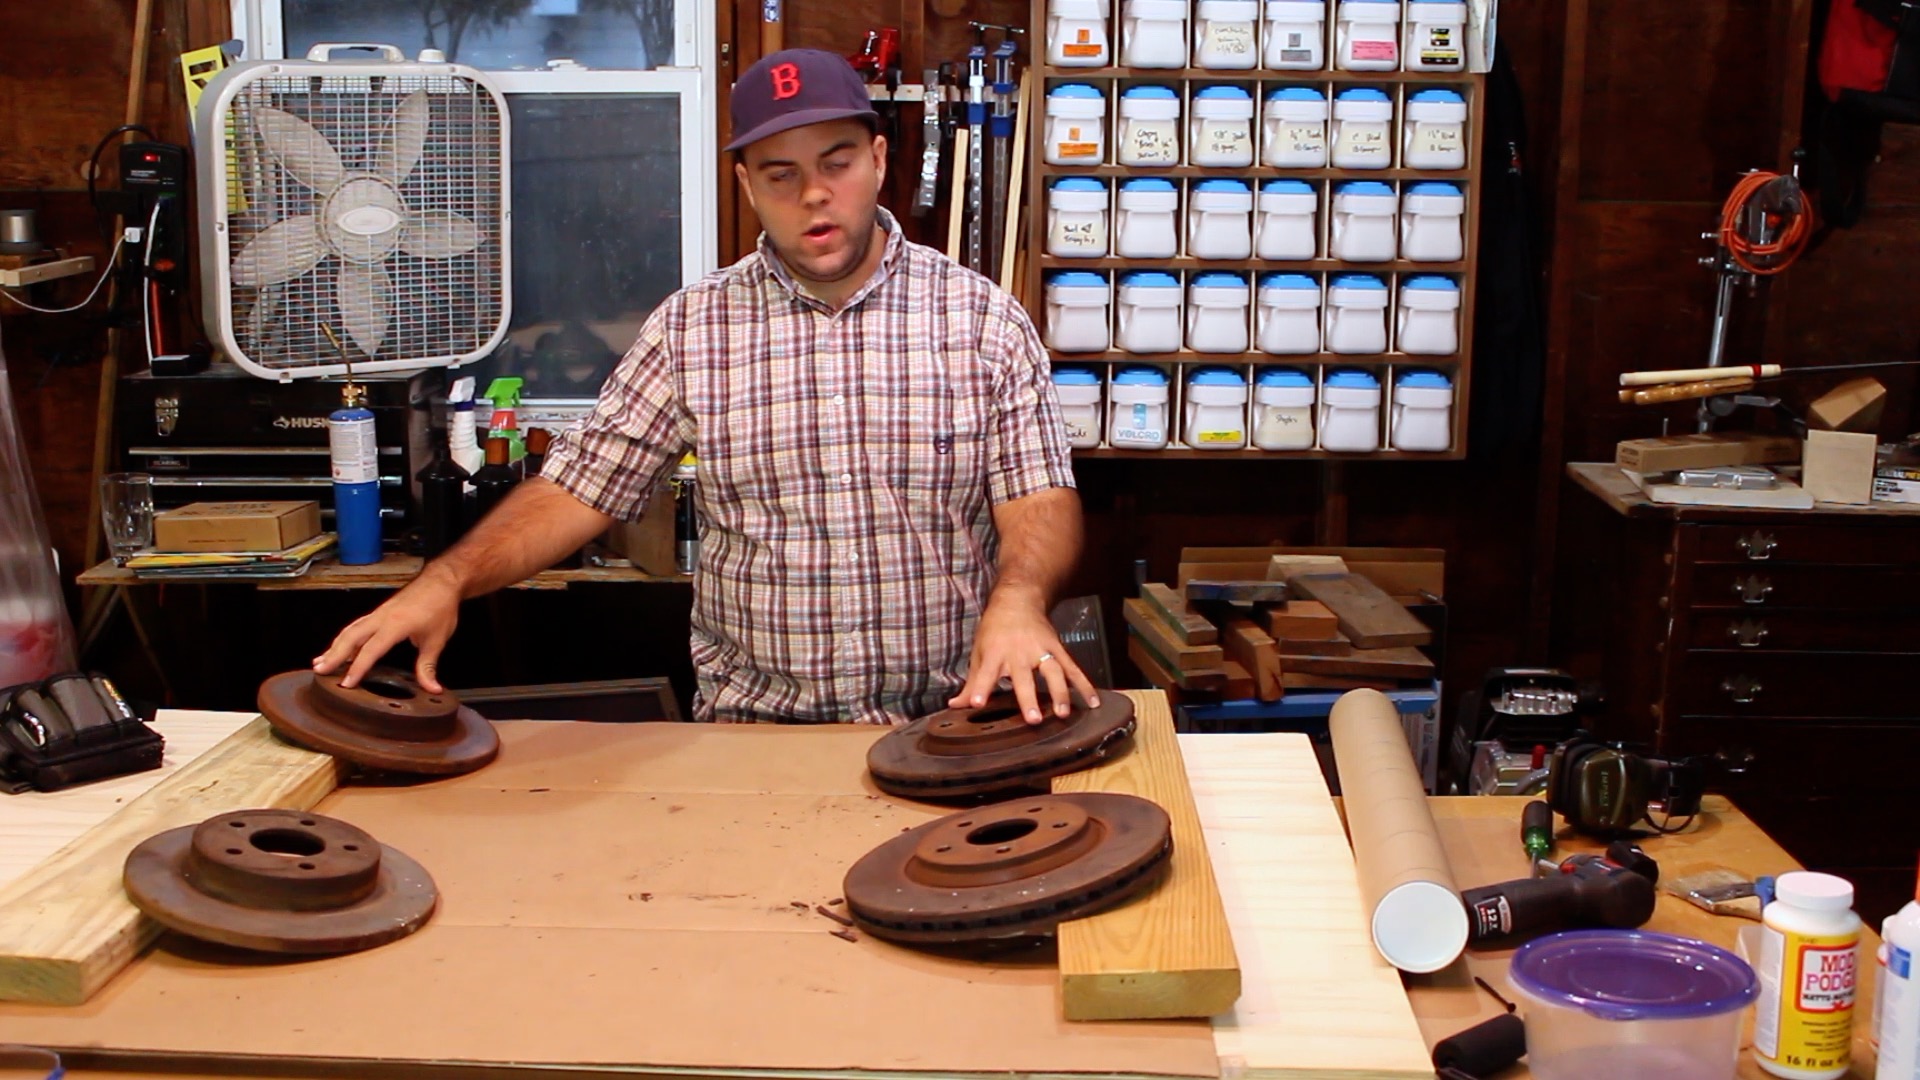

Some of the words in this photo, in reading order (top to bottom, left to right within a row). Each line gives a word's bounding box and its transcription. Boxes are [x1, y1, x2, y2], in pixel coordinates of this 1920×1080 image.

[770, 62, 800, 100] B
[1806, 974, 1855, 991] PODG
[1786, 1055, 1801, 1066] 16
